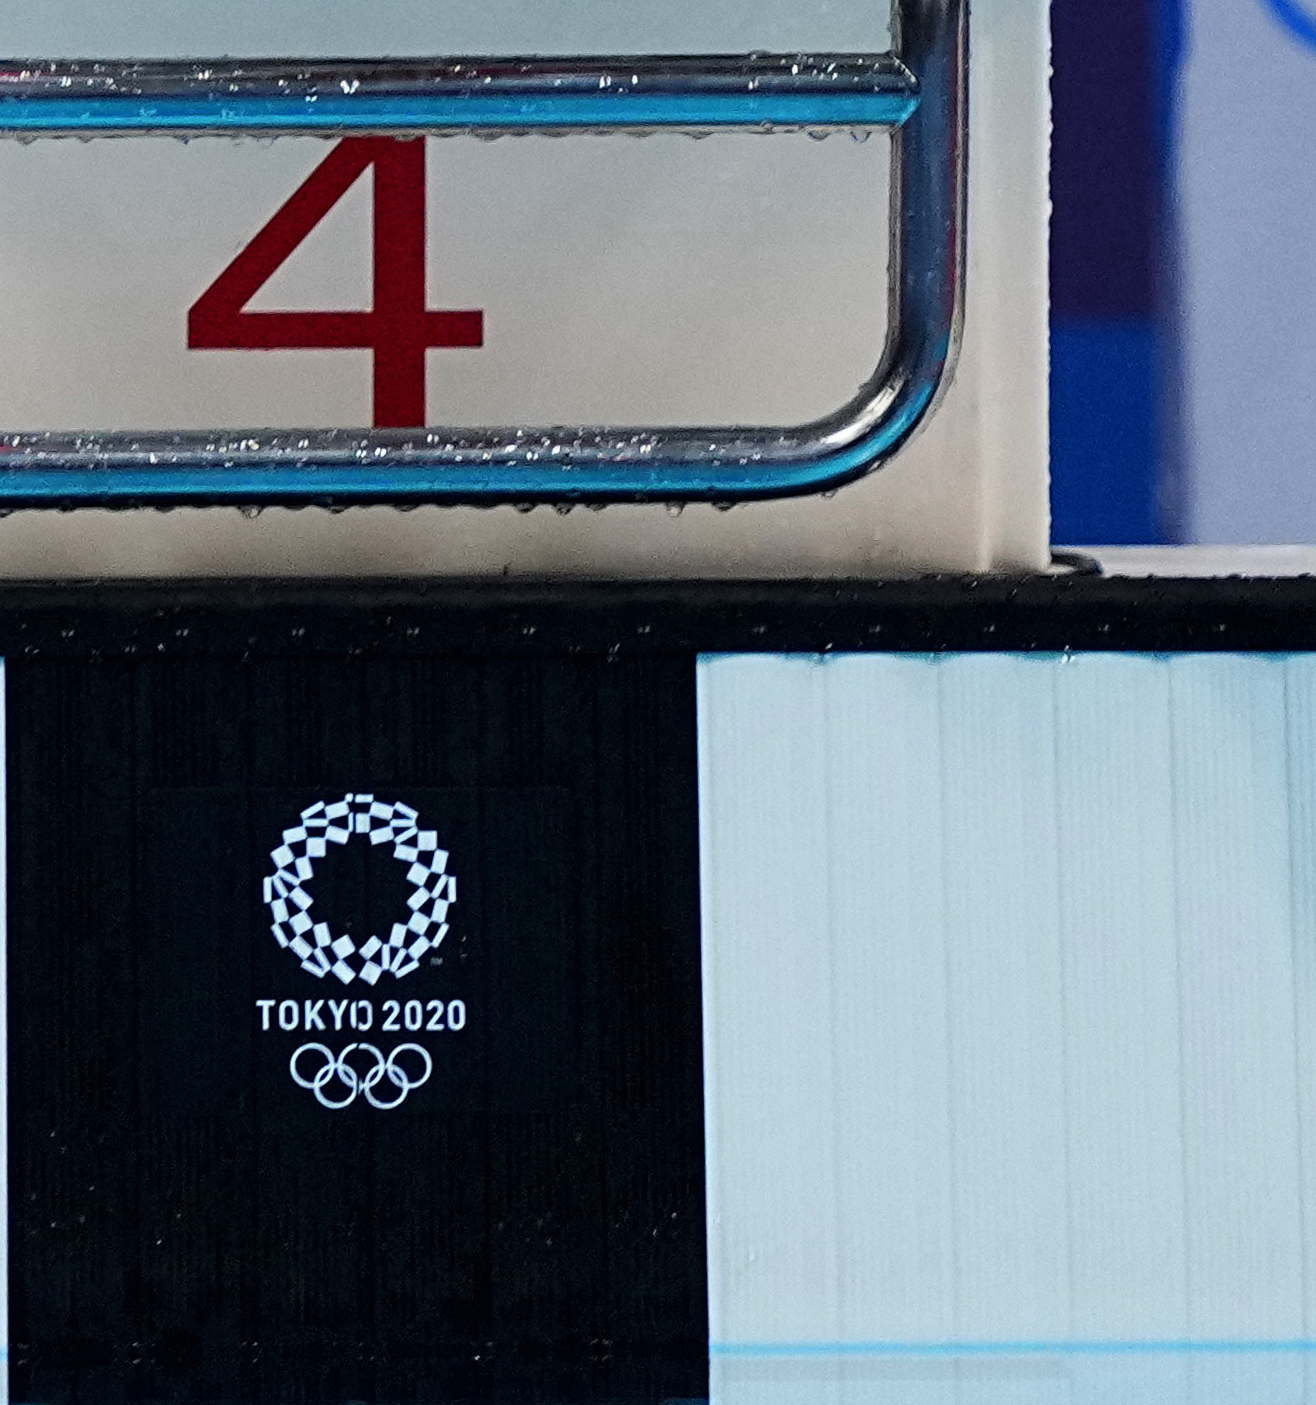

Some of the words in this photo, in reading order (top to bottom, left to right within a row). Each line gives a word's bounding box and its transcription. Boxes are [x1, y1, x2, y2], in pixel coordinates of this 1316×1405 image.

[187, 135, 483, 428] 4
[255, 998, 374, 1032] TOKYO
[381, 998, 467, 1032] 2020
